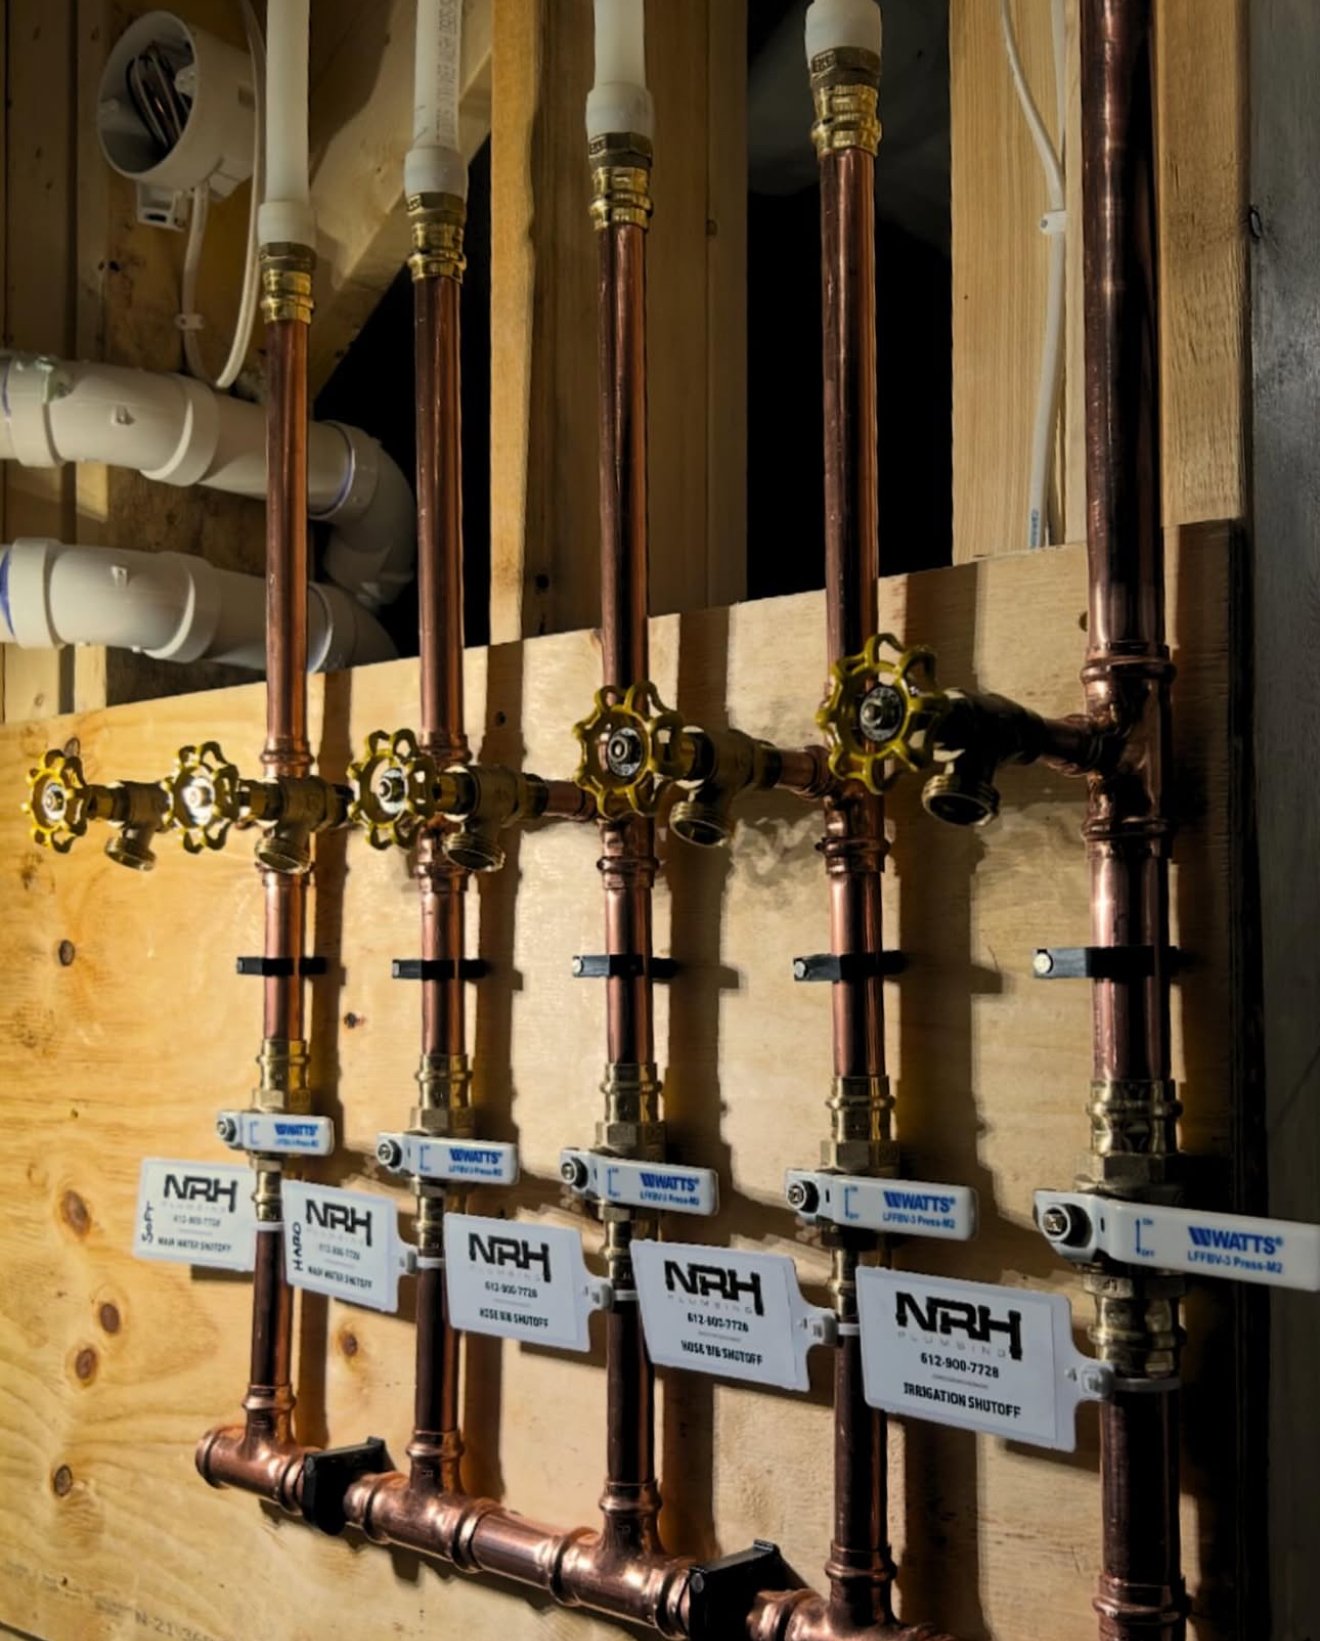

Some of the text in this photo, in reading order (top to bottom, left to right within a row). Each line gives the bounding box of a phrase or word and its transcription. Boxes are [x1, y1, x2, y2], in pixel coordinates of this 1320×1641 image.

[164, 1174, 238, 1213] NRH
[655, 1174, 695, 1193] WATTS
[902, 1193, 950, 1213] WATTS
[306, 1199, 372, 1247] NRH
[469, 1233, 551, 1283] NRH
[1213, 1230, 1276, 1255] WATTS
[664, 1260, 764, 1317] NRH
[896, 1291, 1022, 1361] NRH
[920, 1352, 999, 1378] 612-900-7728
[903, 1381, 1022, 1419] IRRIGATION SHUTOFF
